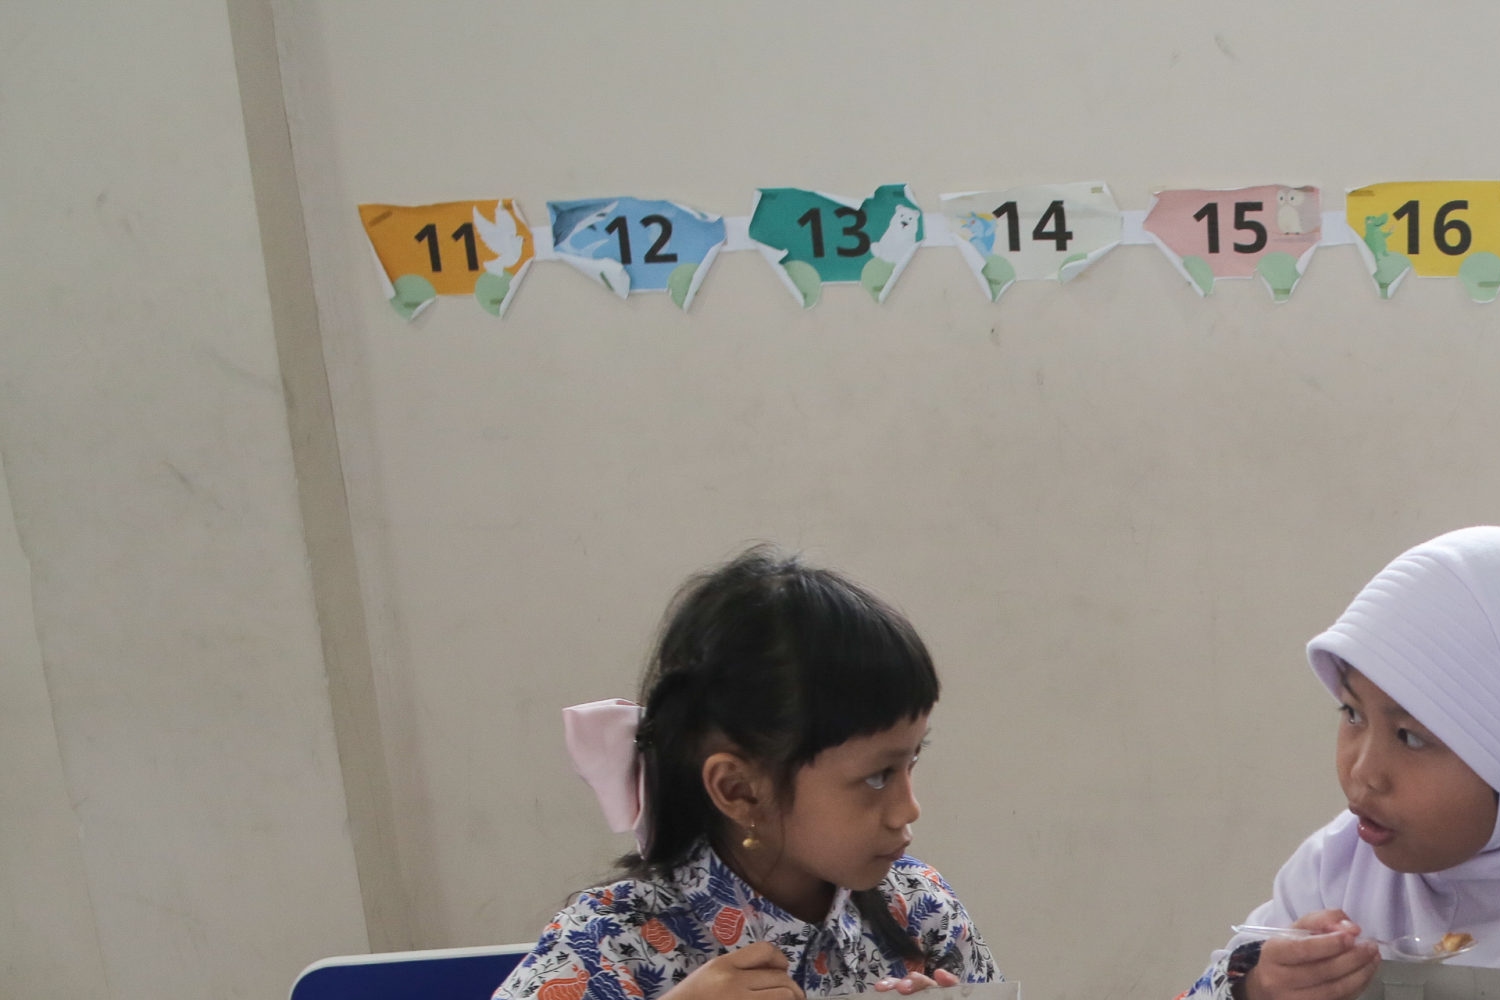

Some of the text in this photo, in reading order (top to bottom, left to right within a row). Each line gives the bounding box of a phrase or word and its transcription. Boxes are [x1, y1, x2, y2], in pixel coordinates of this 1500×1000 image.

[414, 200, 1473, 273] 11 12 13 14 15 16
